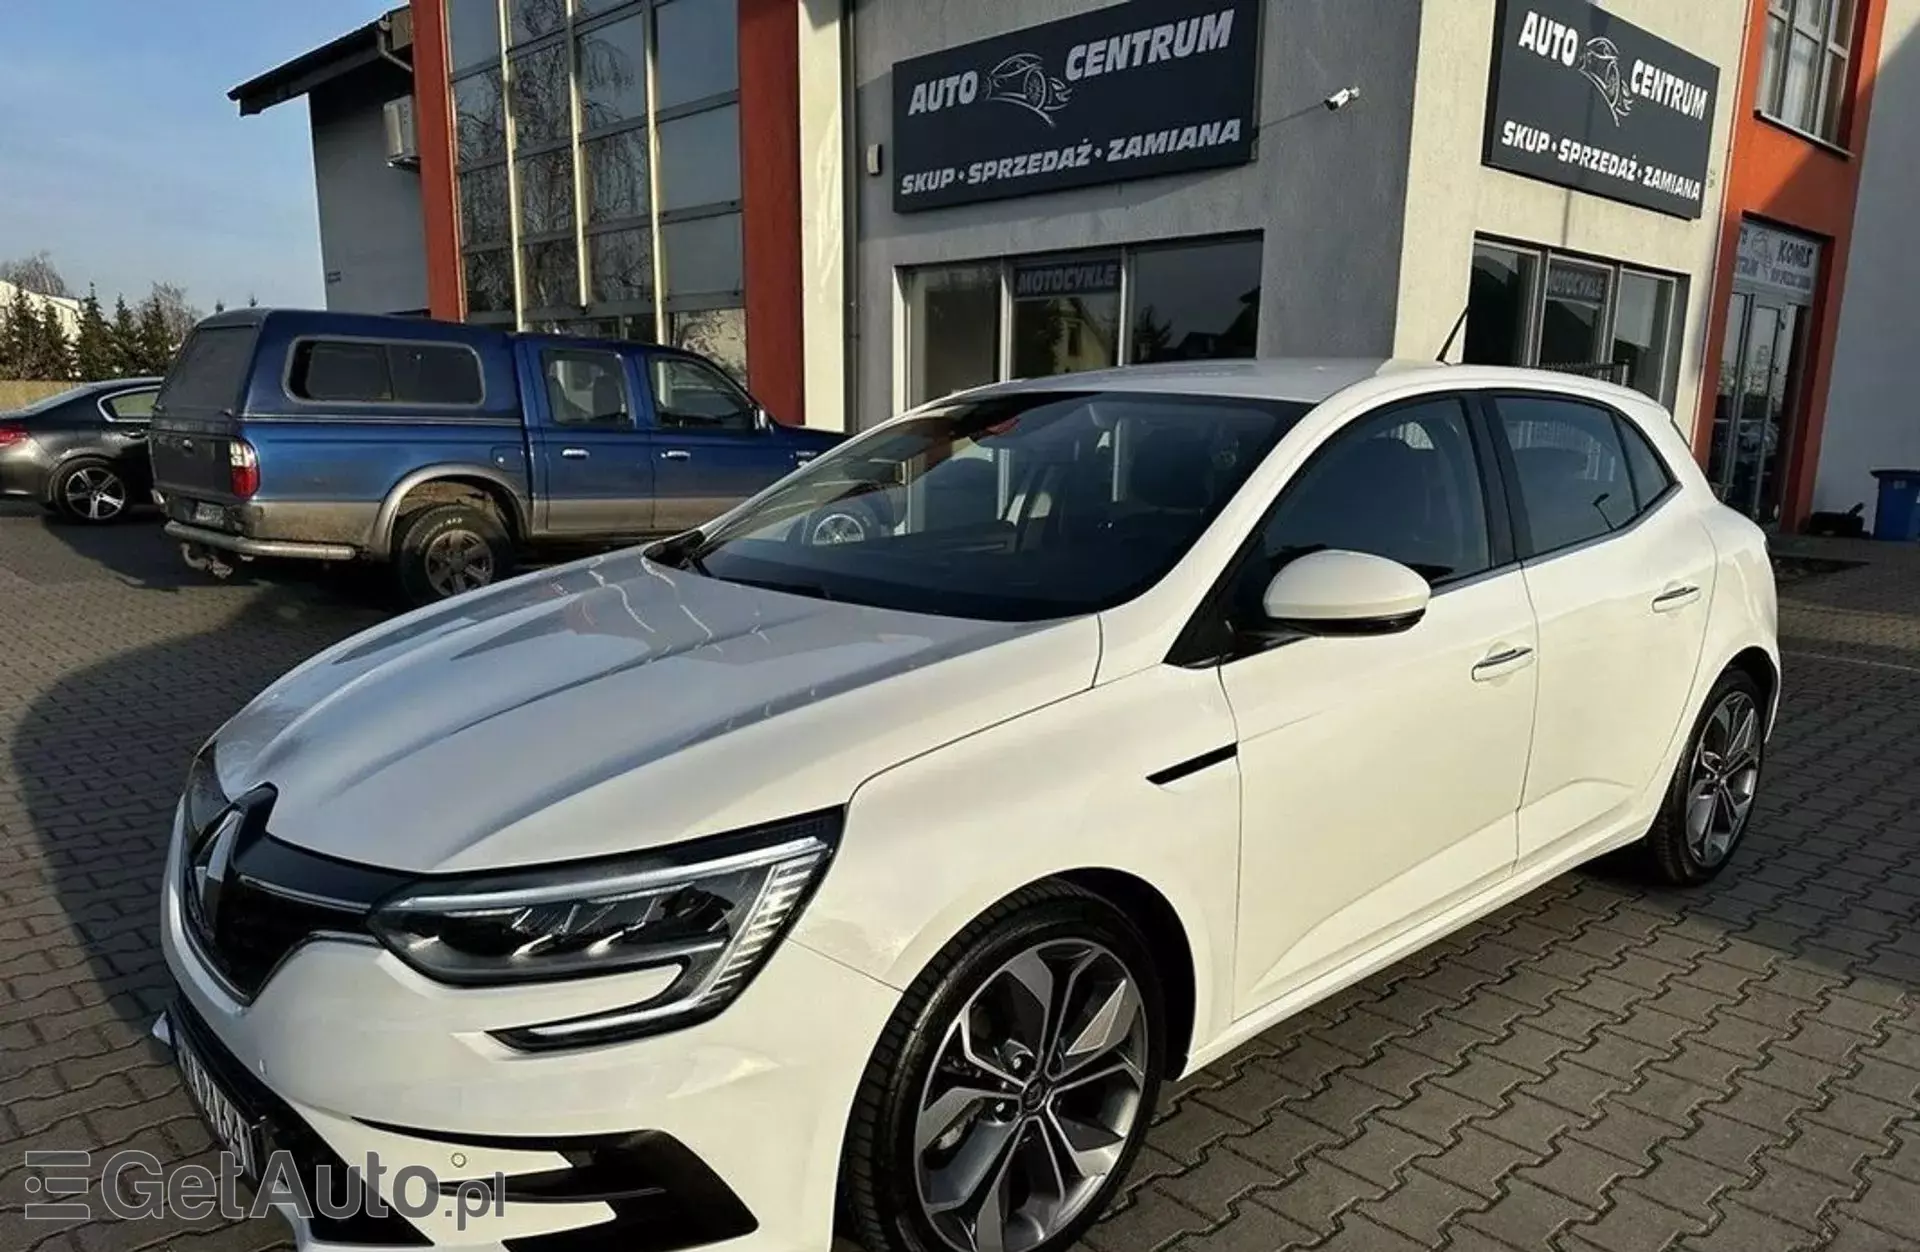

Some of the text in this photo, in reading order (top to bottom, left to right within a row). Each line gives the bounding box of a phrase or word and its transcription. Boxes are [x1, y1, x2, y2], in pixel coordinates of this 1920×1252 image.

[908, 10, 1233, 116] AUTO CENTRUM
[1519, 11, 1707, 120] AUTO CENTRUM
[901, 119, 1241, 195] SKUP SPRZEDAŻ ZAMIANA
[1502, 121, 1700, 201] SKUP SPRZEDAŻ ZAMIANA
[1017, 265, 1117, 293] MOTOCYKLE
